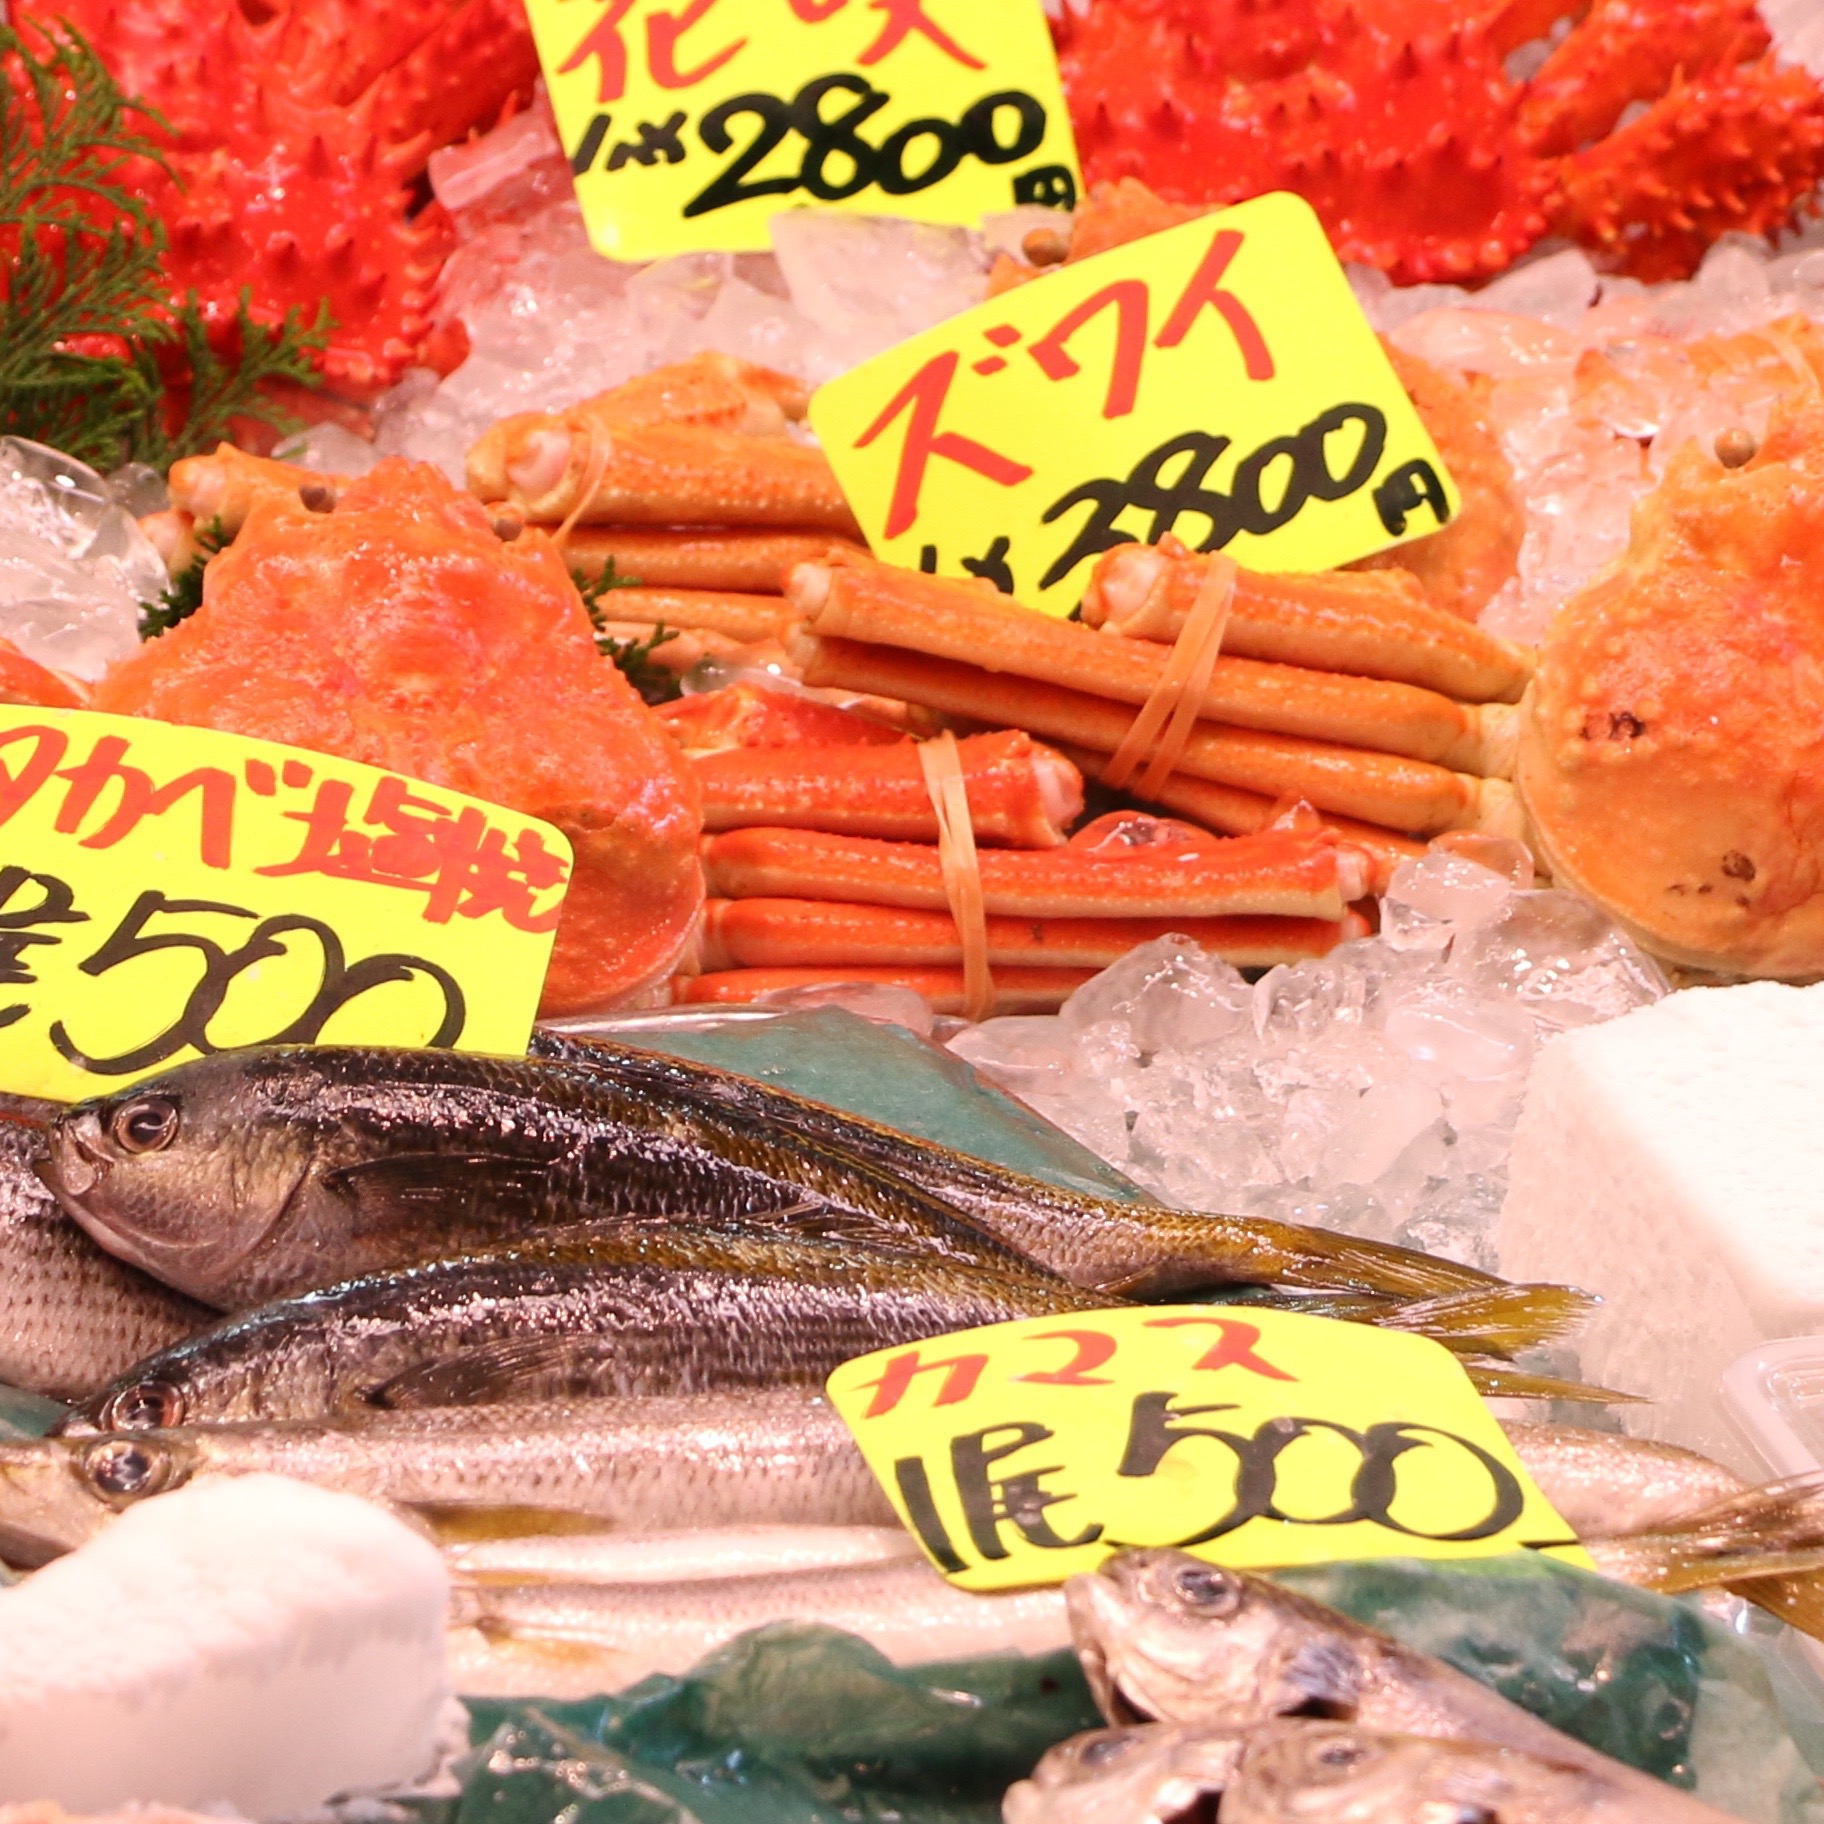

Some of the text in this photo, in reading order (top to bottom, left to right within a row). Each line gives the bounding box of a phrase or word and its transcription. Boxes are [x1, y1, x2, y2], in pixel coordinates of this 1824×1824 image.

[852, 229, 1276, 540] ズワイ
[852, 1317, 1298, 1420] カマス
